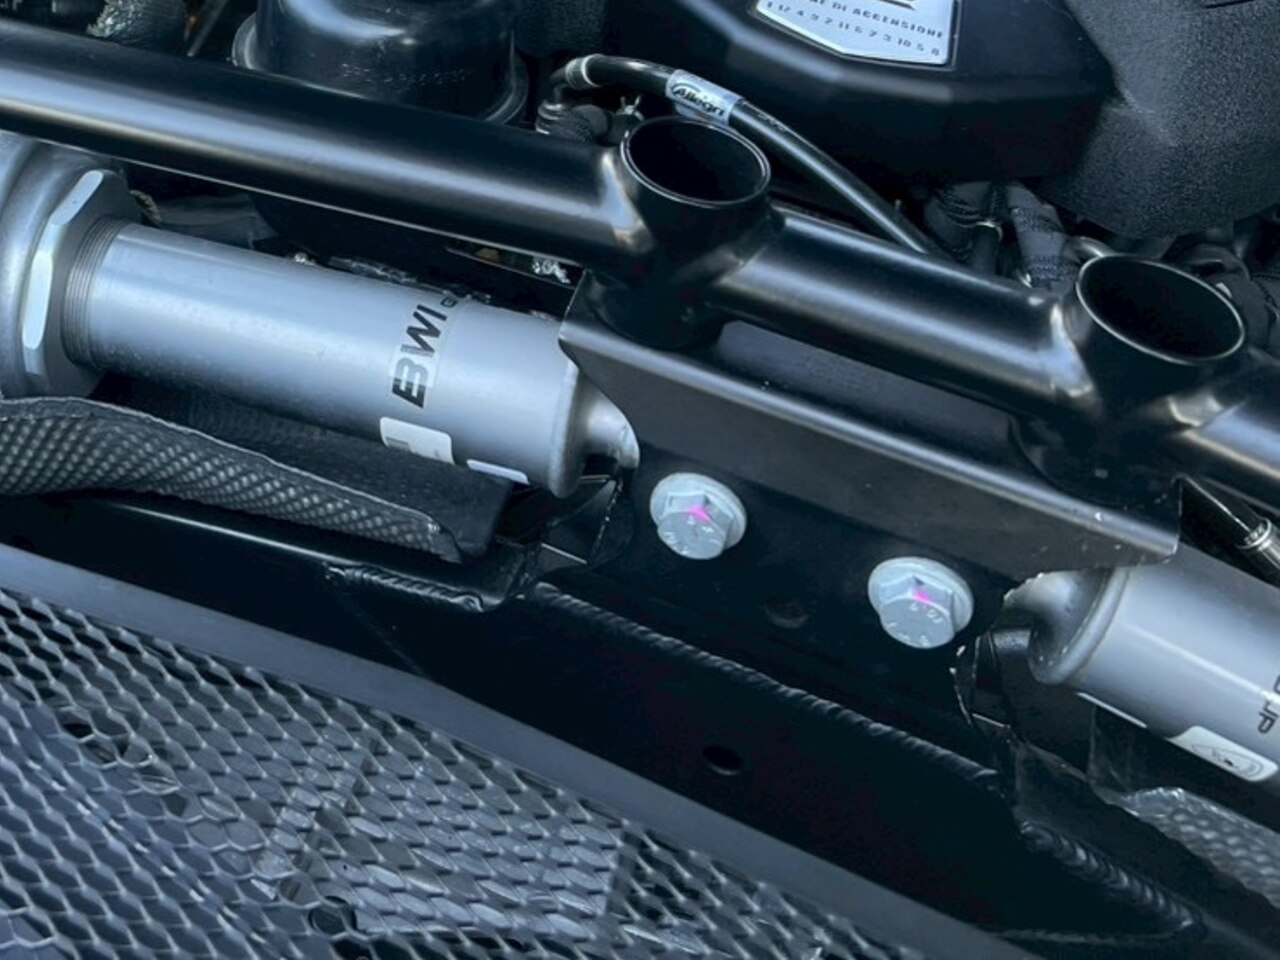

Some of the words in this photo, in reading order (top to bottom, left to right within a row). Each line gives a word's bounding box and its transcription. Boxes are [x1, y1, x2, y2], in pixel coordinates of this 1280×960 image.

[852, 8, 943, 38] ACCENSIONE
[672, 87, 725, 116] Allegri
[392, 304, 447, 409] BWI
